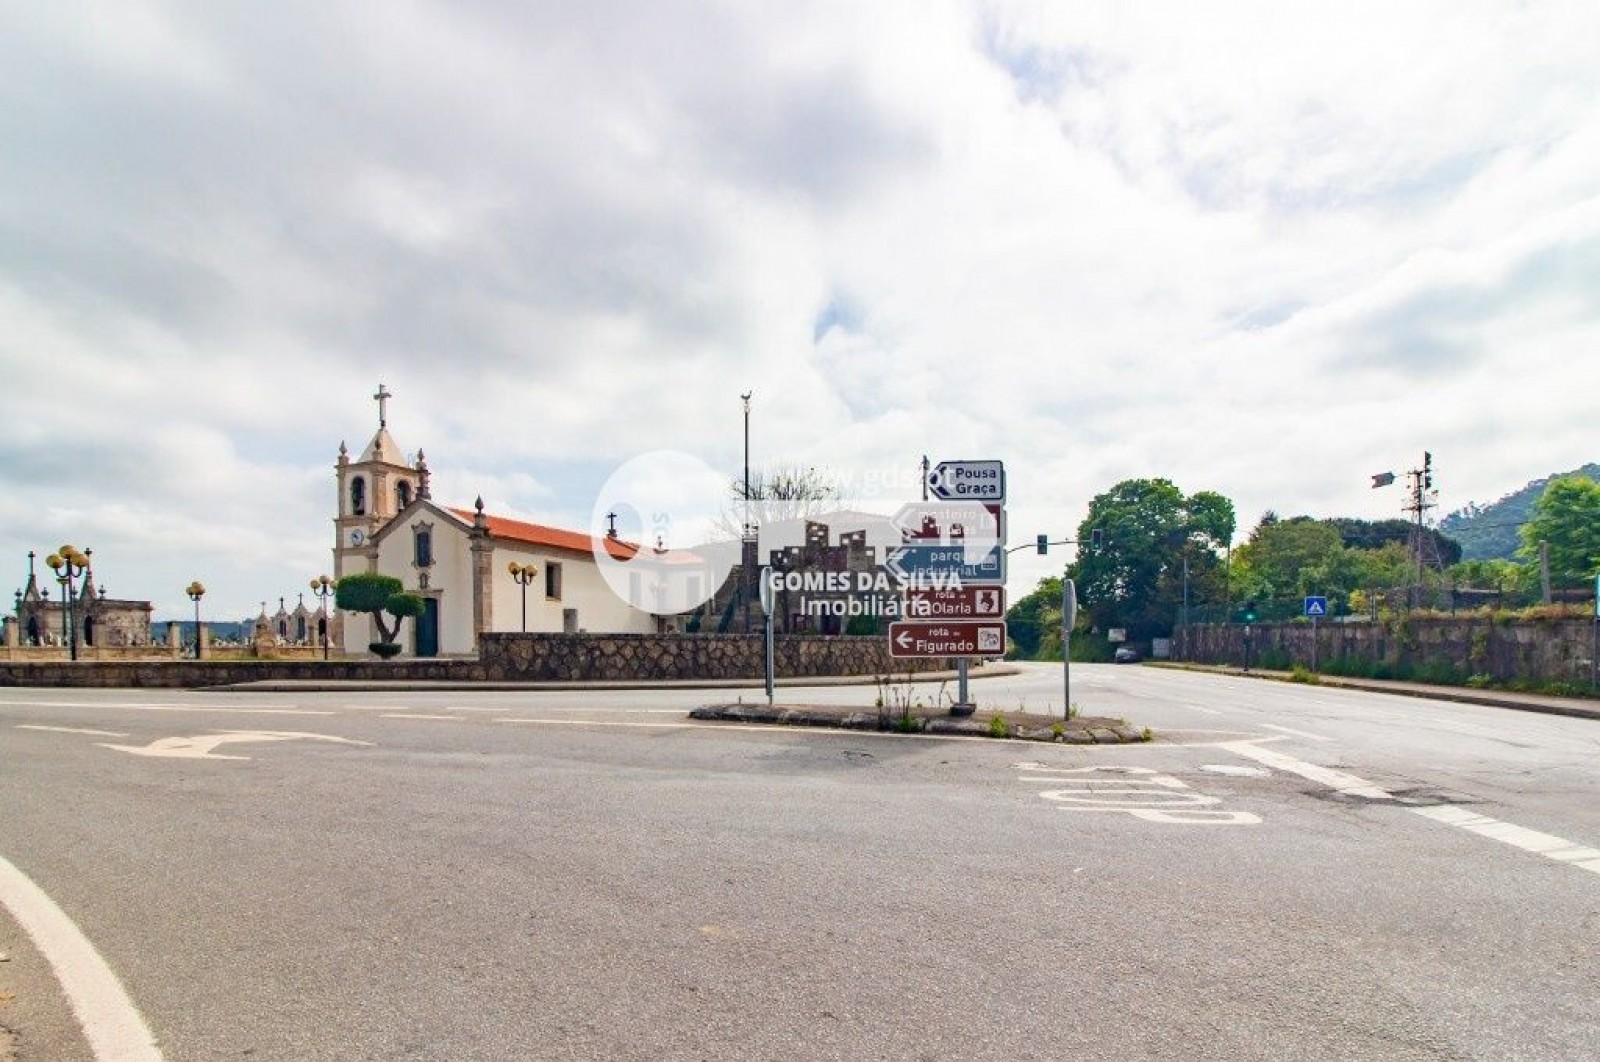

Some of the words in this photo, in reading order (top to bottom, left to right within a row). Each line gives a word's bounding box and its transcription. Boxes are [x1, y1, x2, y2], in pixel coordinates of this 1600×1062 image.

[955, 467, 996, 479] Pousa
[955, 483, 996, 496] Graça
[932, 602, 972, 615] Olaria
[929, 627, 950, 637] rota
[916, 639, 975, 653] Figurado
